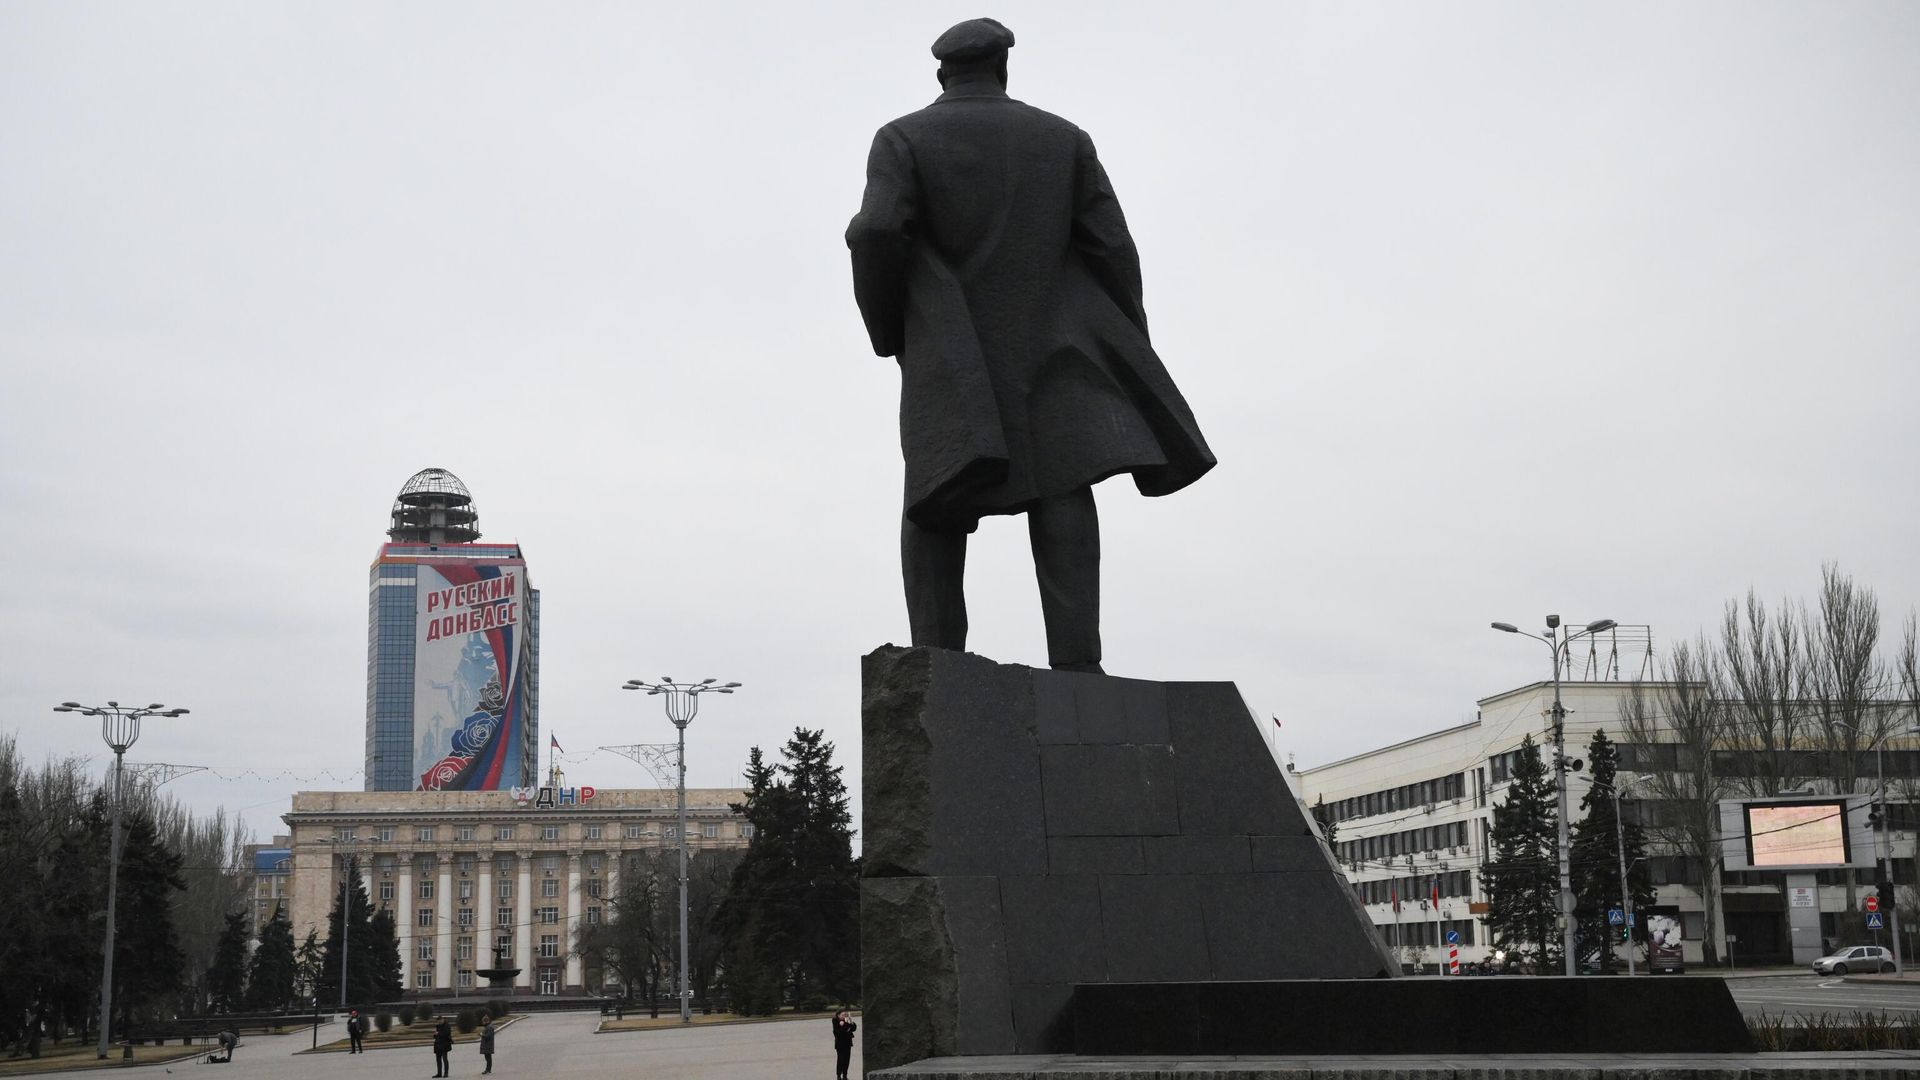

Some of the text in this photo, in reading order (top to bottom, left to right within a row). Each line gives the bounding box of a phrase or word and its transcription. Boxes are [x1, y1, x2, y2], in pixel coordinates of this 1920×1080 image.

[427, 572, 515, 613] РУССКИЙ
[426, 602, 518, 642] ДОНБАСС
[535, 786, 596, 808] ДНР
